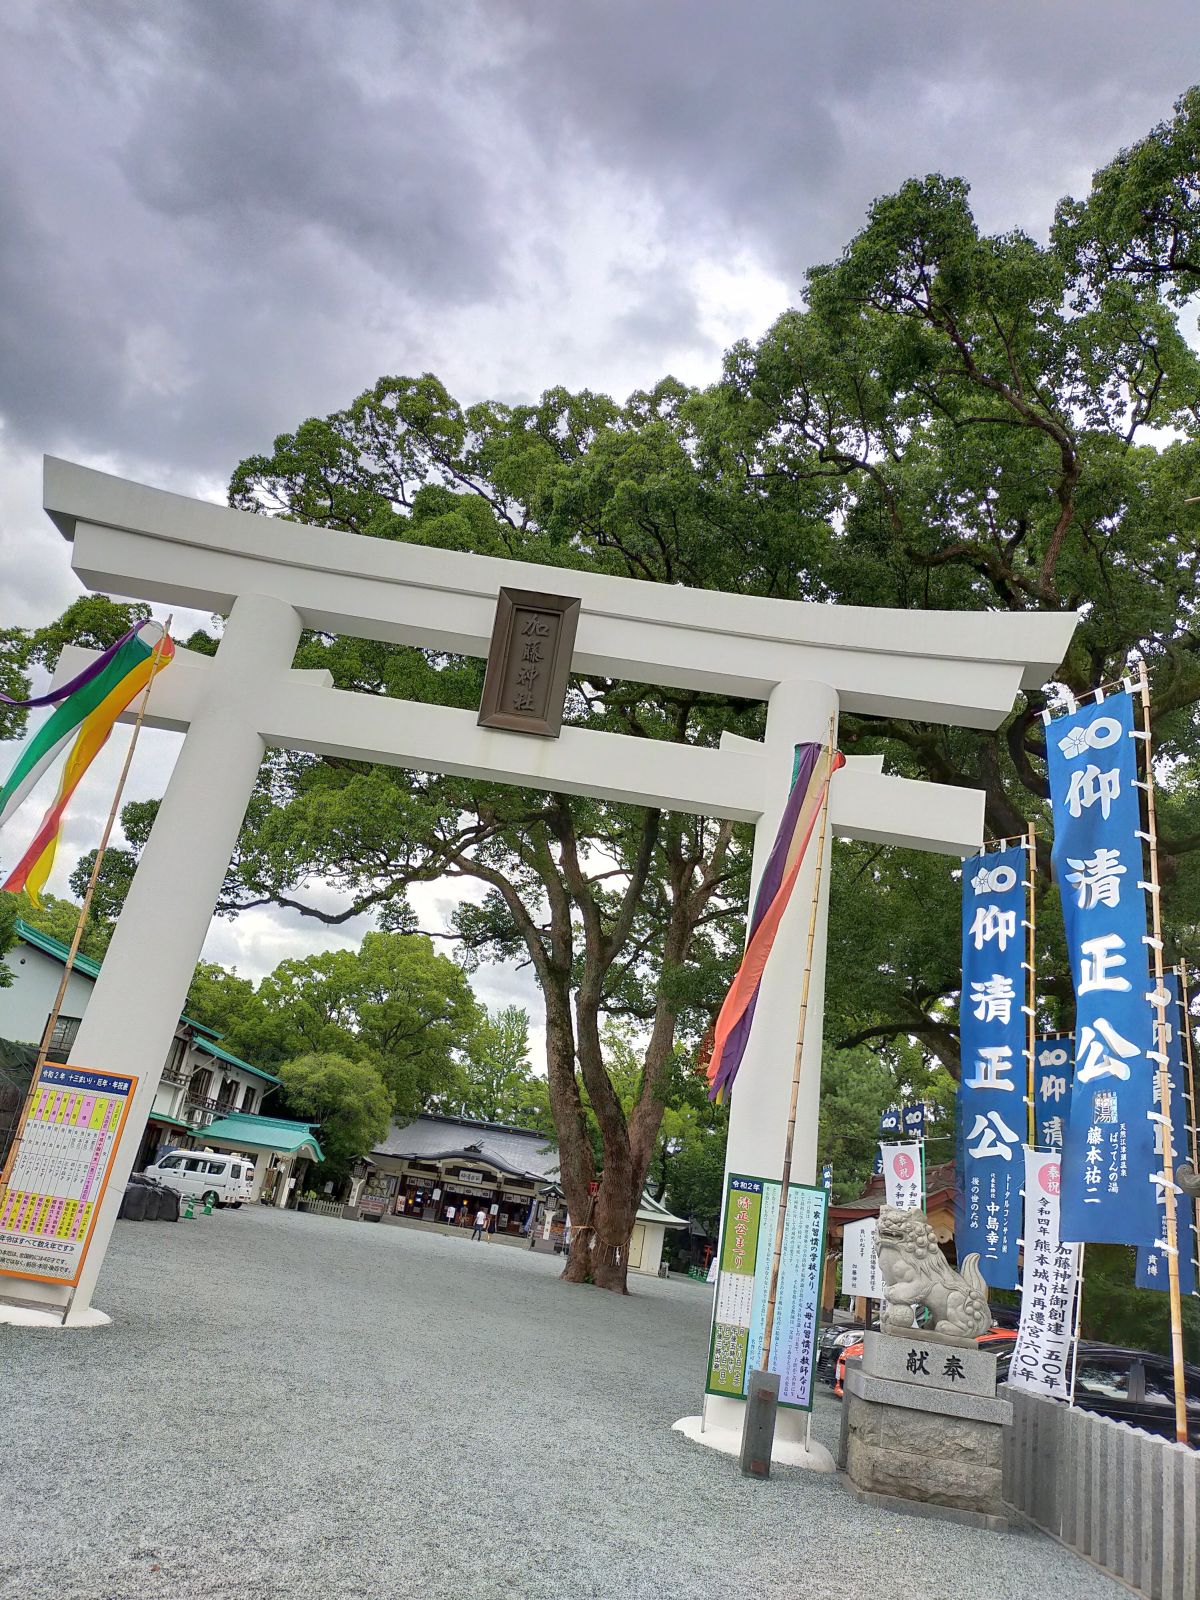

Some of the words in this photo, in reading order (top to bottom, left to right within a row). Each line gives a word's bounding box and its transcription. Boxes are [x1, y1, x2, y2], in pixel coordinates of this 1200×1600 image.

[513, 614, 550, 712] 加藤神社
[1064, 764, 1141, 1083] 仰清正公
[966, 904, 1020, 1161] 仰清正公
[732, 1180, 760, 1192] 令和2年
[1047, 1165, 1060, 1195] 奉祝
[1083, 1126, 1104, 1204] 藤本祐二
[1107, 1132, 1120, 1194] ばってんの湯
[895, 1182, 905, 1210] 令和四
[969, 1177, 980, 1229] 後の世のため
[985, 1201, 1000, 1259] 中島幸二
[796, 1301, 814, 1400] 父母は習慣の教師なり」
